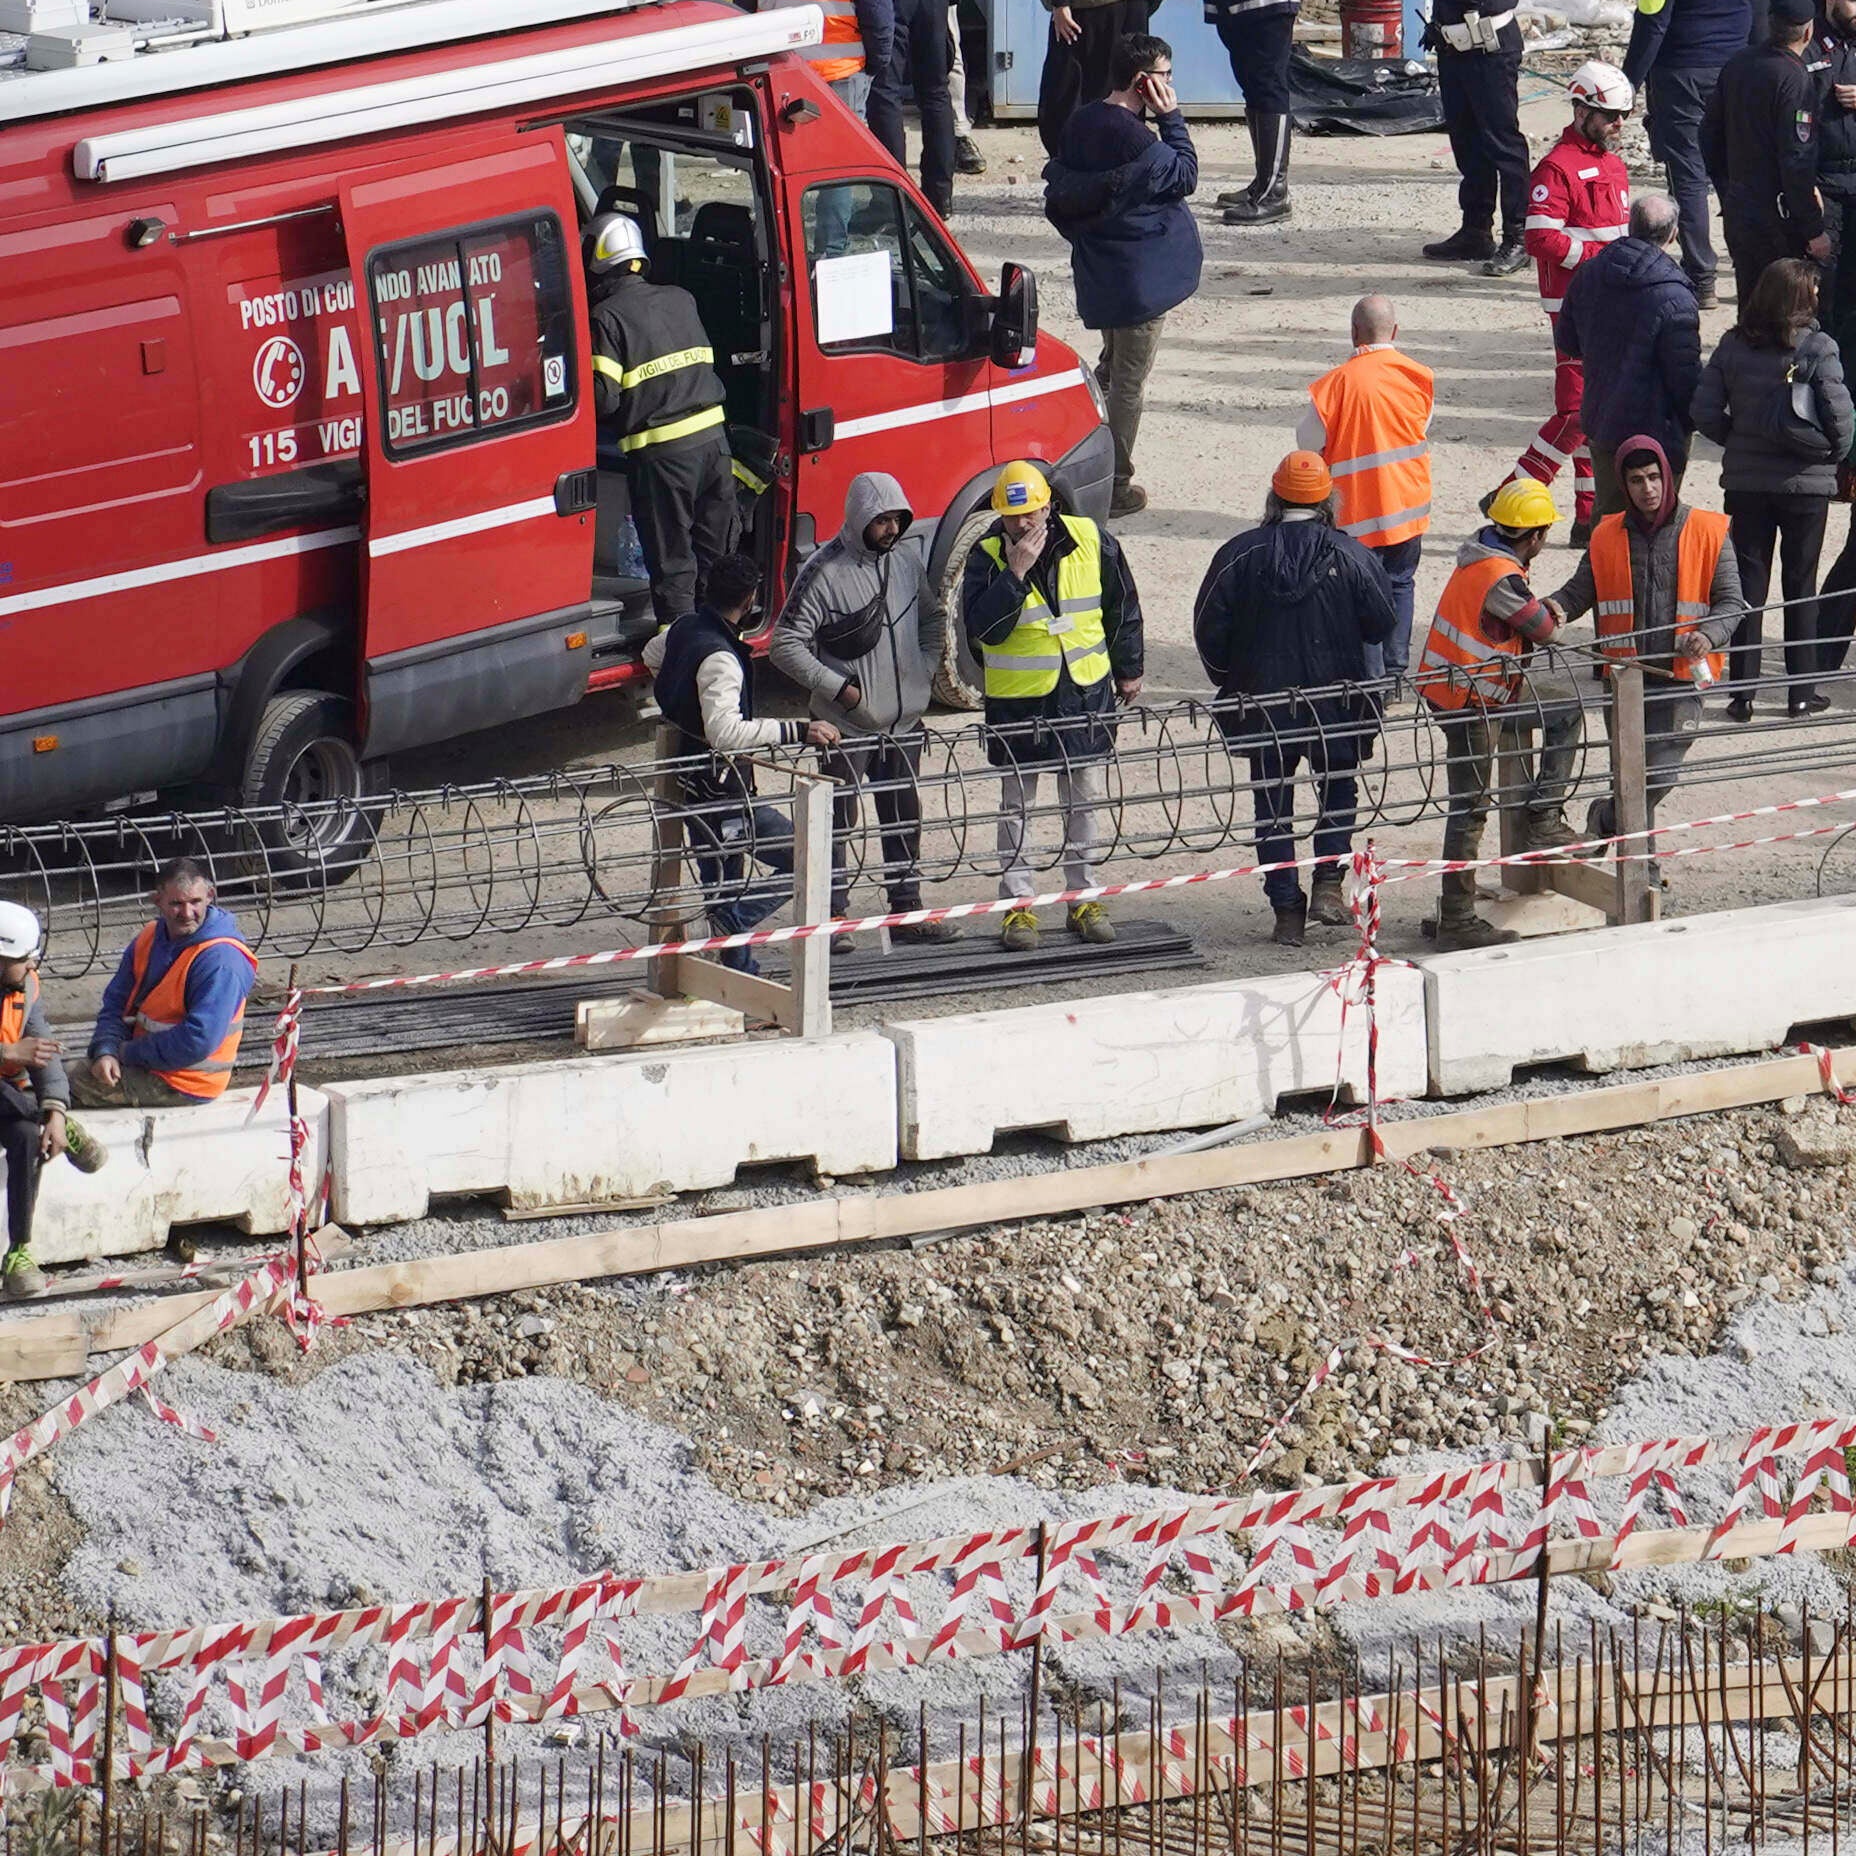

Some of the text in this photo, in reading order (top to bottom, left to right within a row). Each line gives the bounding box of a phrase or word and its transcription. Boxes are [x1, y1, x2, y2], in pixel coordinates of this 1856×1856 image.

[239, 291, 297, 329] POSTO
[302, 288, 321, 318] DI
[249, 387, 509, 468] 115 VIGI DEL FUOCO
